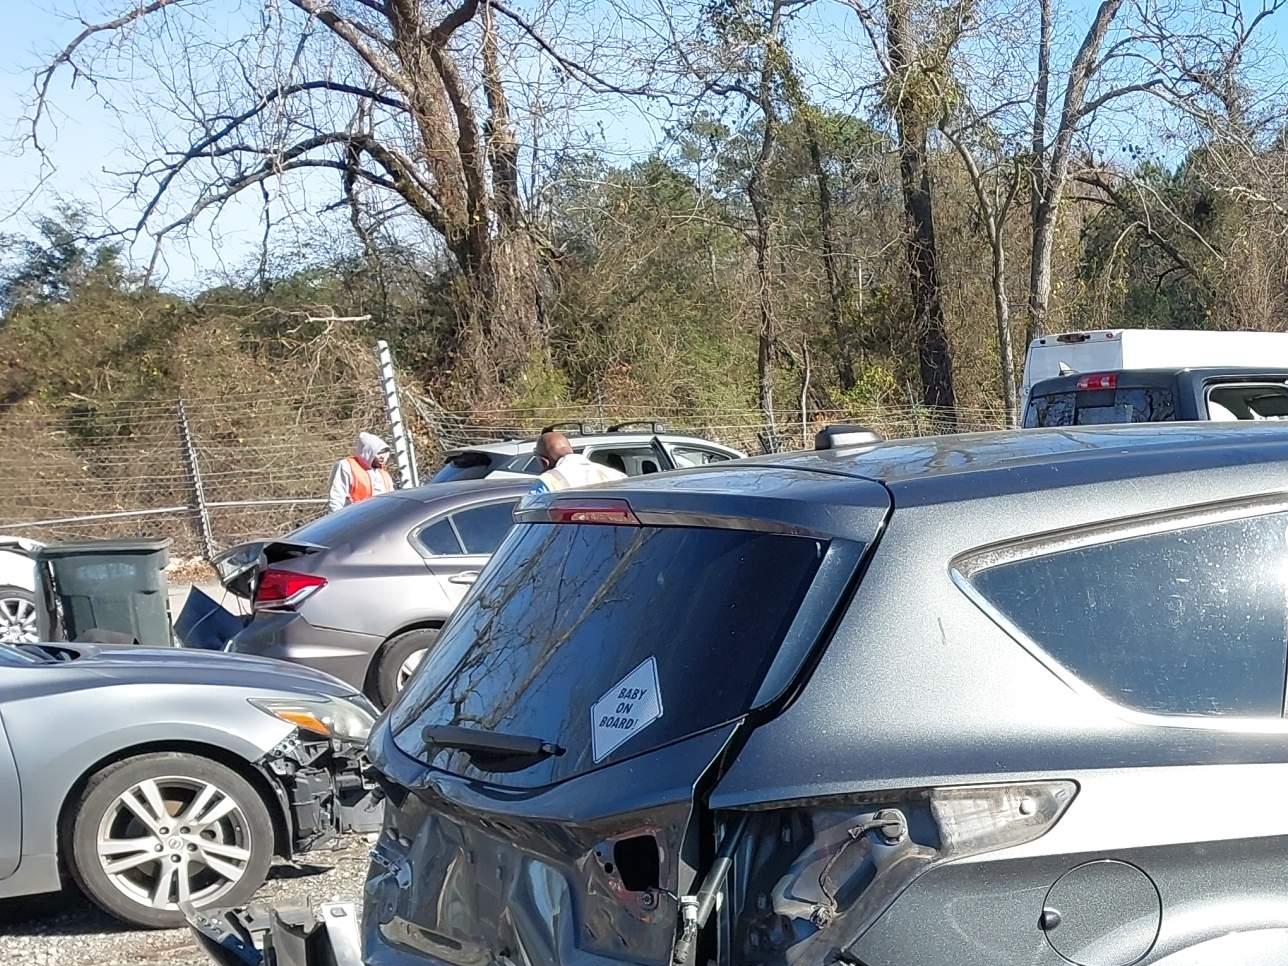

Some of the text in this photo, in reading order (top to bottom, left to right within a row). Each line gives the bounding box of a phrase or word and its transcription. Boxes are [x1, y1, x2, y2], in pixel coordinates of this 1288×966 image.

[617, 688, 647, 700] BABY
[616, 703, 633, 714] ON
[599, 717, 638, 730] BOARD!
